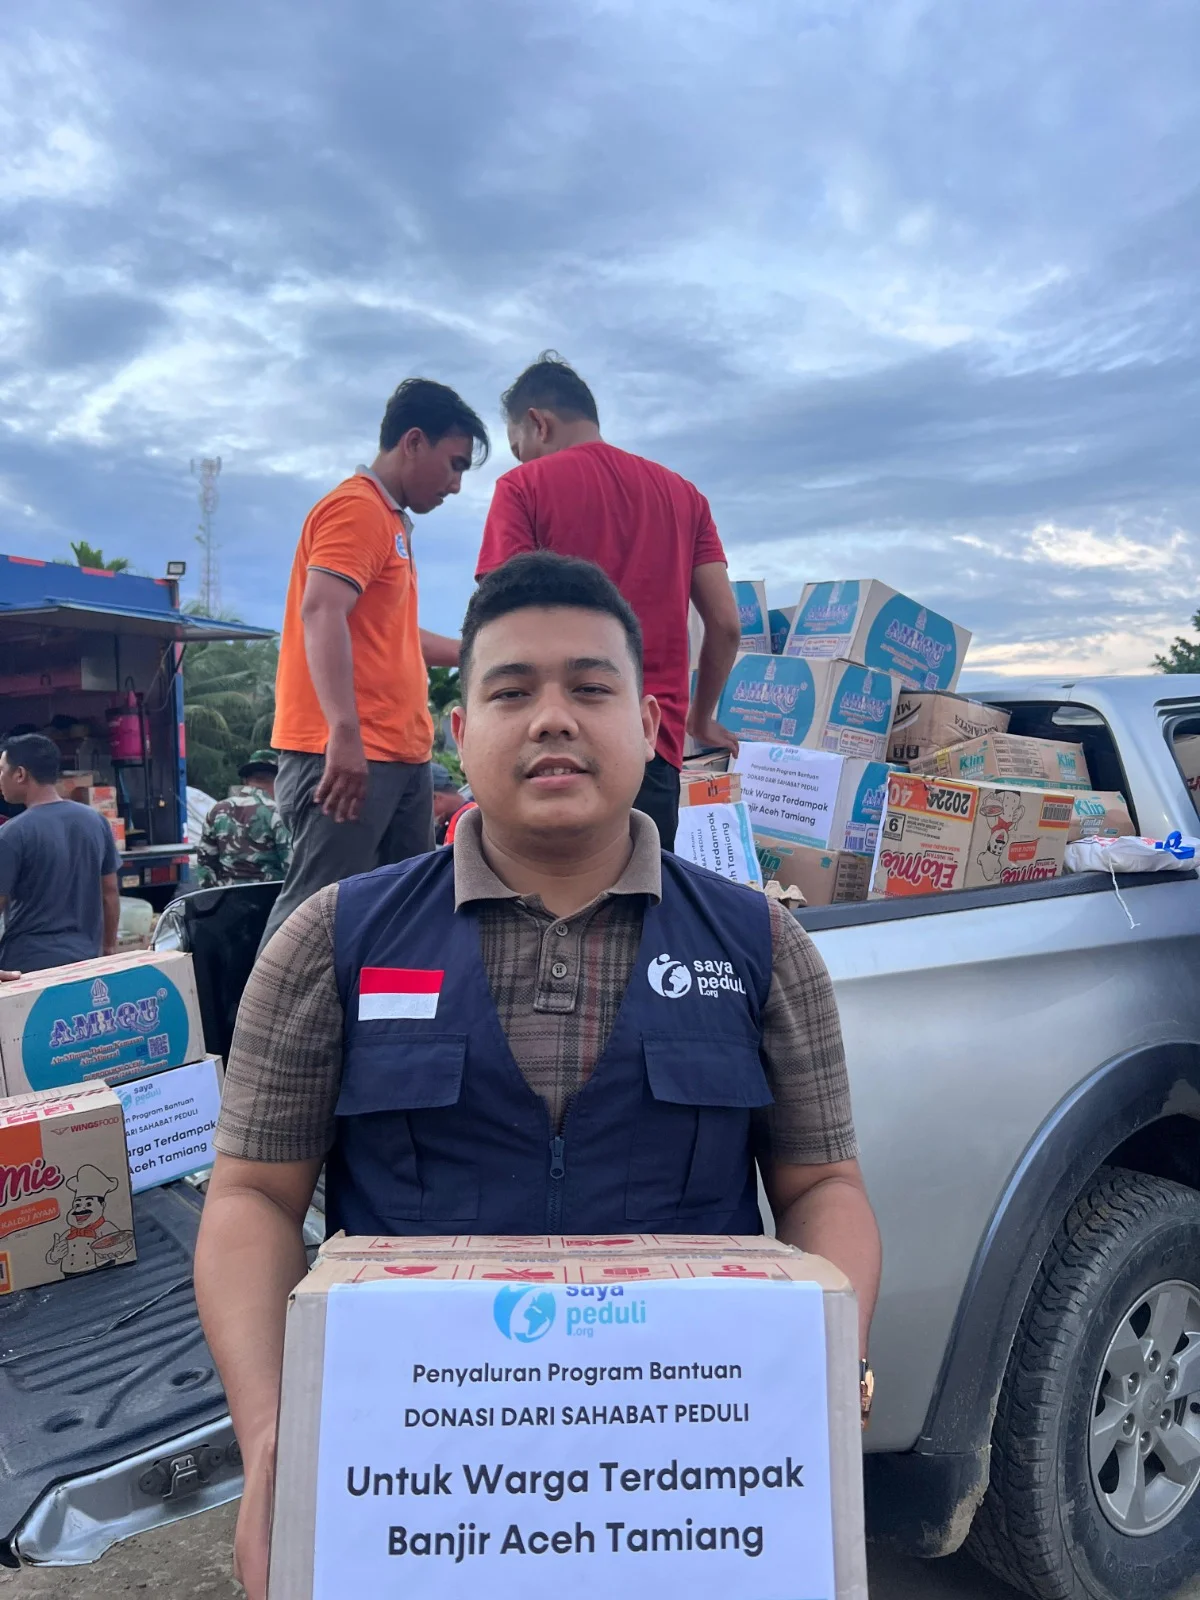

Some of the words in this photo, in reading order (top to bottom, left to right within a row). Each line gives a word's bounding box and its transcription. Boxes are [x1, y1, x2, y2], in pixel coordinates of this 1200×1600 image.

[884, 618, 945, 669] AMIQU
[732, 679, 800, 714] AMIQU
[959, 754, 985, 770] Klin
[1056, 750, 1077, 769] Klin
[776, 767, 798, 777] Program
[797, 771, 820, 780] Bantuan
[777, 778, 801, 789] SAHABAT
[800, 783, 820, 792] PEDULI
[755, 789, 781, 803] Warga
[782, 794, 829, 812] Terdampak
[889, 782, 913, 806] 40
[759, 805, 780, 817] Aceh
[781, 809, 817, 827] Tamiang
[1074, 800, 1106, 816] Klin
[707, 812, 722, 872] Terdampak
[722, 822, 736, 868] Tamiang
[881, 852, 959, 889] EkoMie
[693, 960, 734, 976] saya
[696, 974, 747, 996] pedul
[49, 996, 160, 1048] AMIQU
[134, 1083, 153, 1094] saya
[132, 1106, 164, 1122] Program
[164, 1098, 195, 1112] Bantuan
[71, 1116, 120, 1133] WINGSFOOD
[126, 1128, 138, 1137] ARI
[138, 1117, 174, 1134] SAHABAT
[174, 1108, 199, 1121] PEDULI
[127, 1142, 152, 1158] arga
[153, 1119, 217, 1149] Terdampak
[158, 1142, 208, 1165] Tamiang
[0, 1159, 63, 1204] Mie
[1, 1212, 31, 1229] KALDU
[32, 1206, 57, 1220] AYAM
[566, 1285, 625, 1302] saya
[566, 1301, 647, 1336] peduli
[412, 1362, 542, 1387] Penyaluran
[548, 1362, 643, 1386] Program
[650, 1361, 742, 1380] Bantuan
[404, 1407, 494, 1427] DONASI
[501, 1406, 555, 1426] DARI
[561, 1404, 668, 1425] SAHABAT
[675, 1402, 749, 1423] PEDULI
[346, 1463, 453, 1497] Untuk
[462, 1463, 589, 1502] Warga
[599, 1456, 804, 1497] Terdampak
[388, 1522, 491, 1563] Banjir
[499, 1522, 595, 1554] Aceh
[605, 1517, 763, 1557] Tamiang
